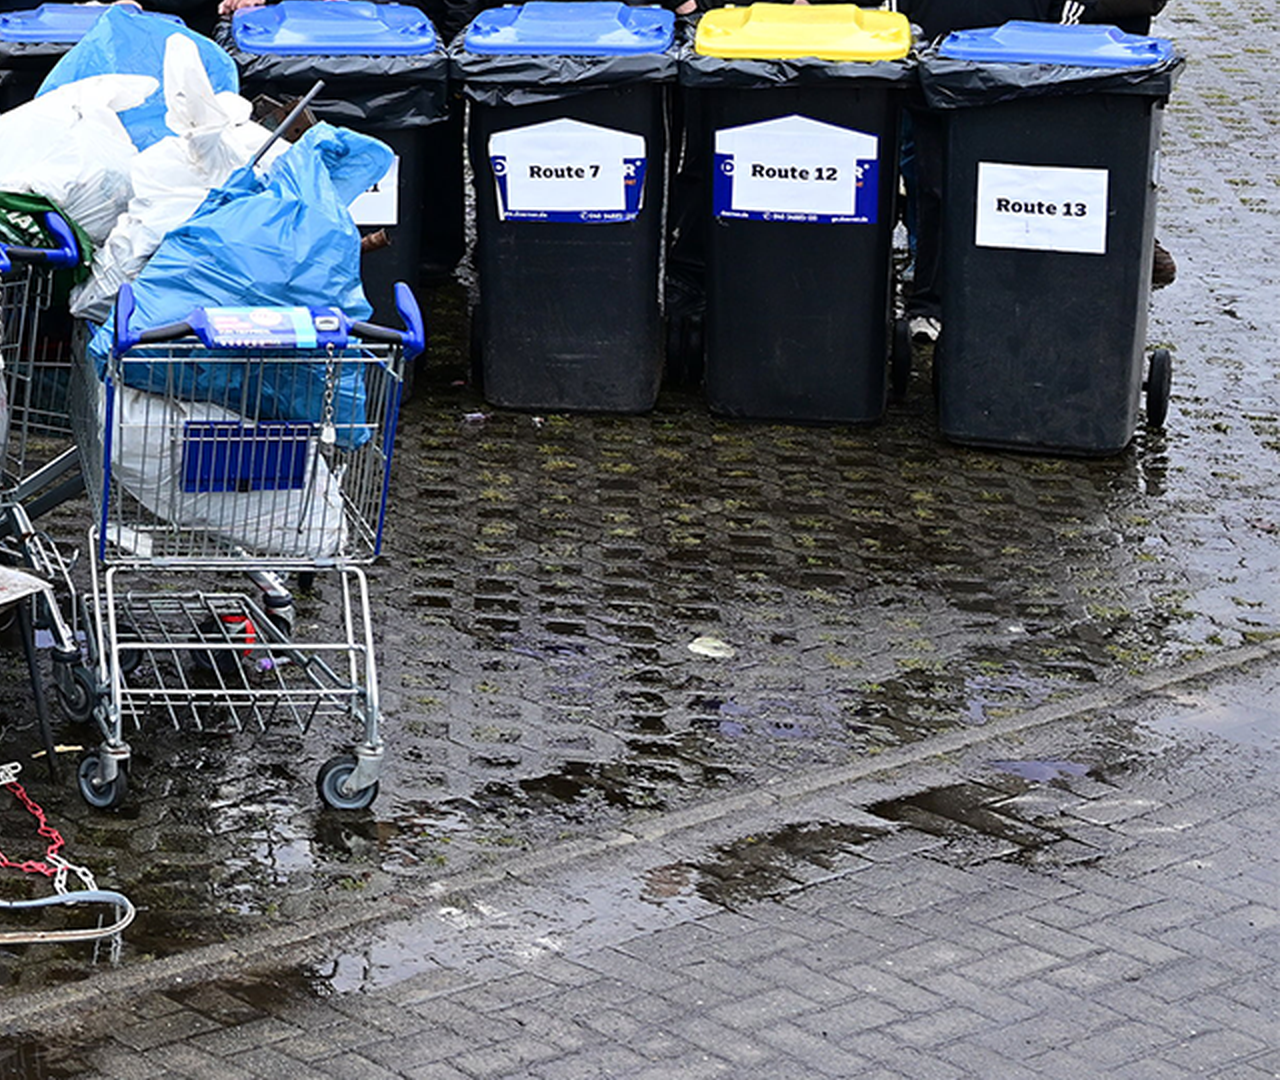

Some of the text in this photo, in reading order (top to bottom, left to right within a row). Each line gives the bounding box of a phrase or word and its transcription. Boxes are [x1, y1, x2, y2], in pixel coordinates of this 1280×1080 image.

[529, 165, 600, 178] Route 7
[751, 164, 837, 181] Route 12
[996, 198, 1087, 217] Route 13
